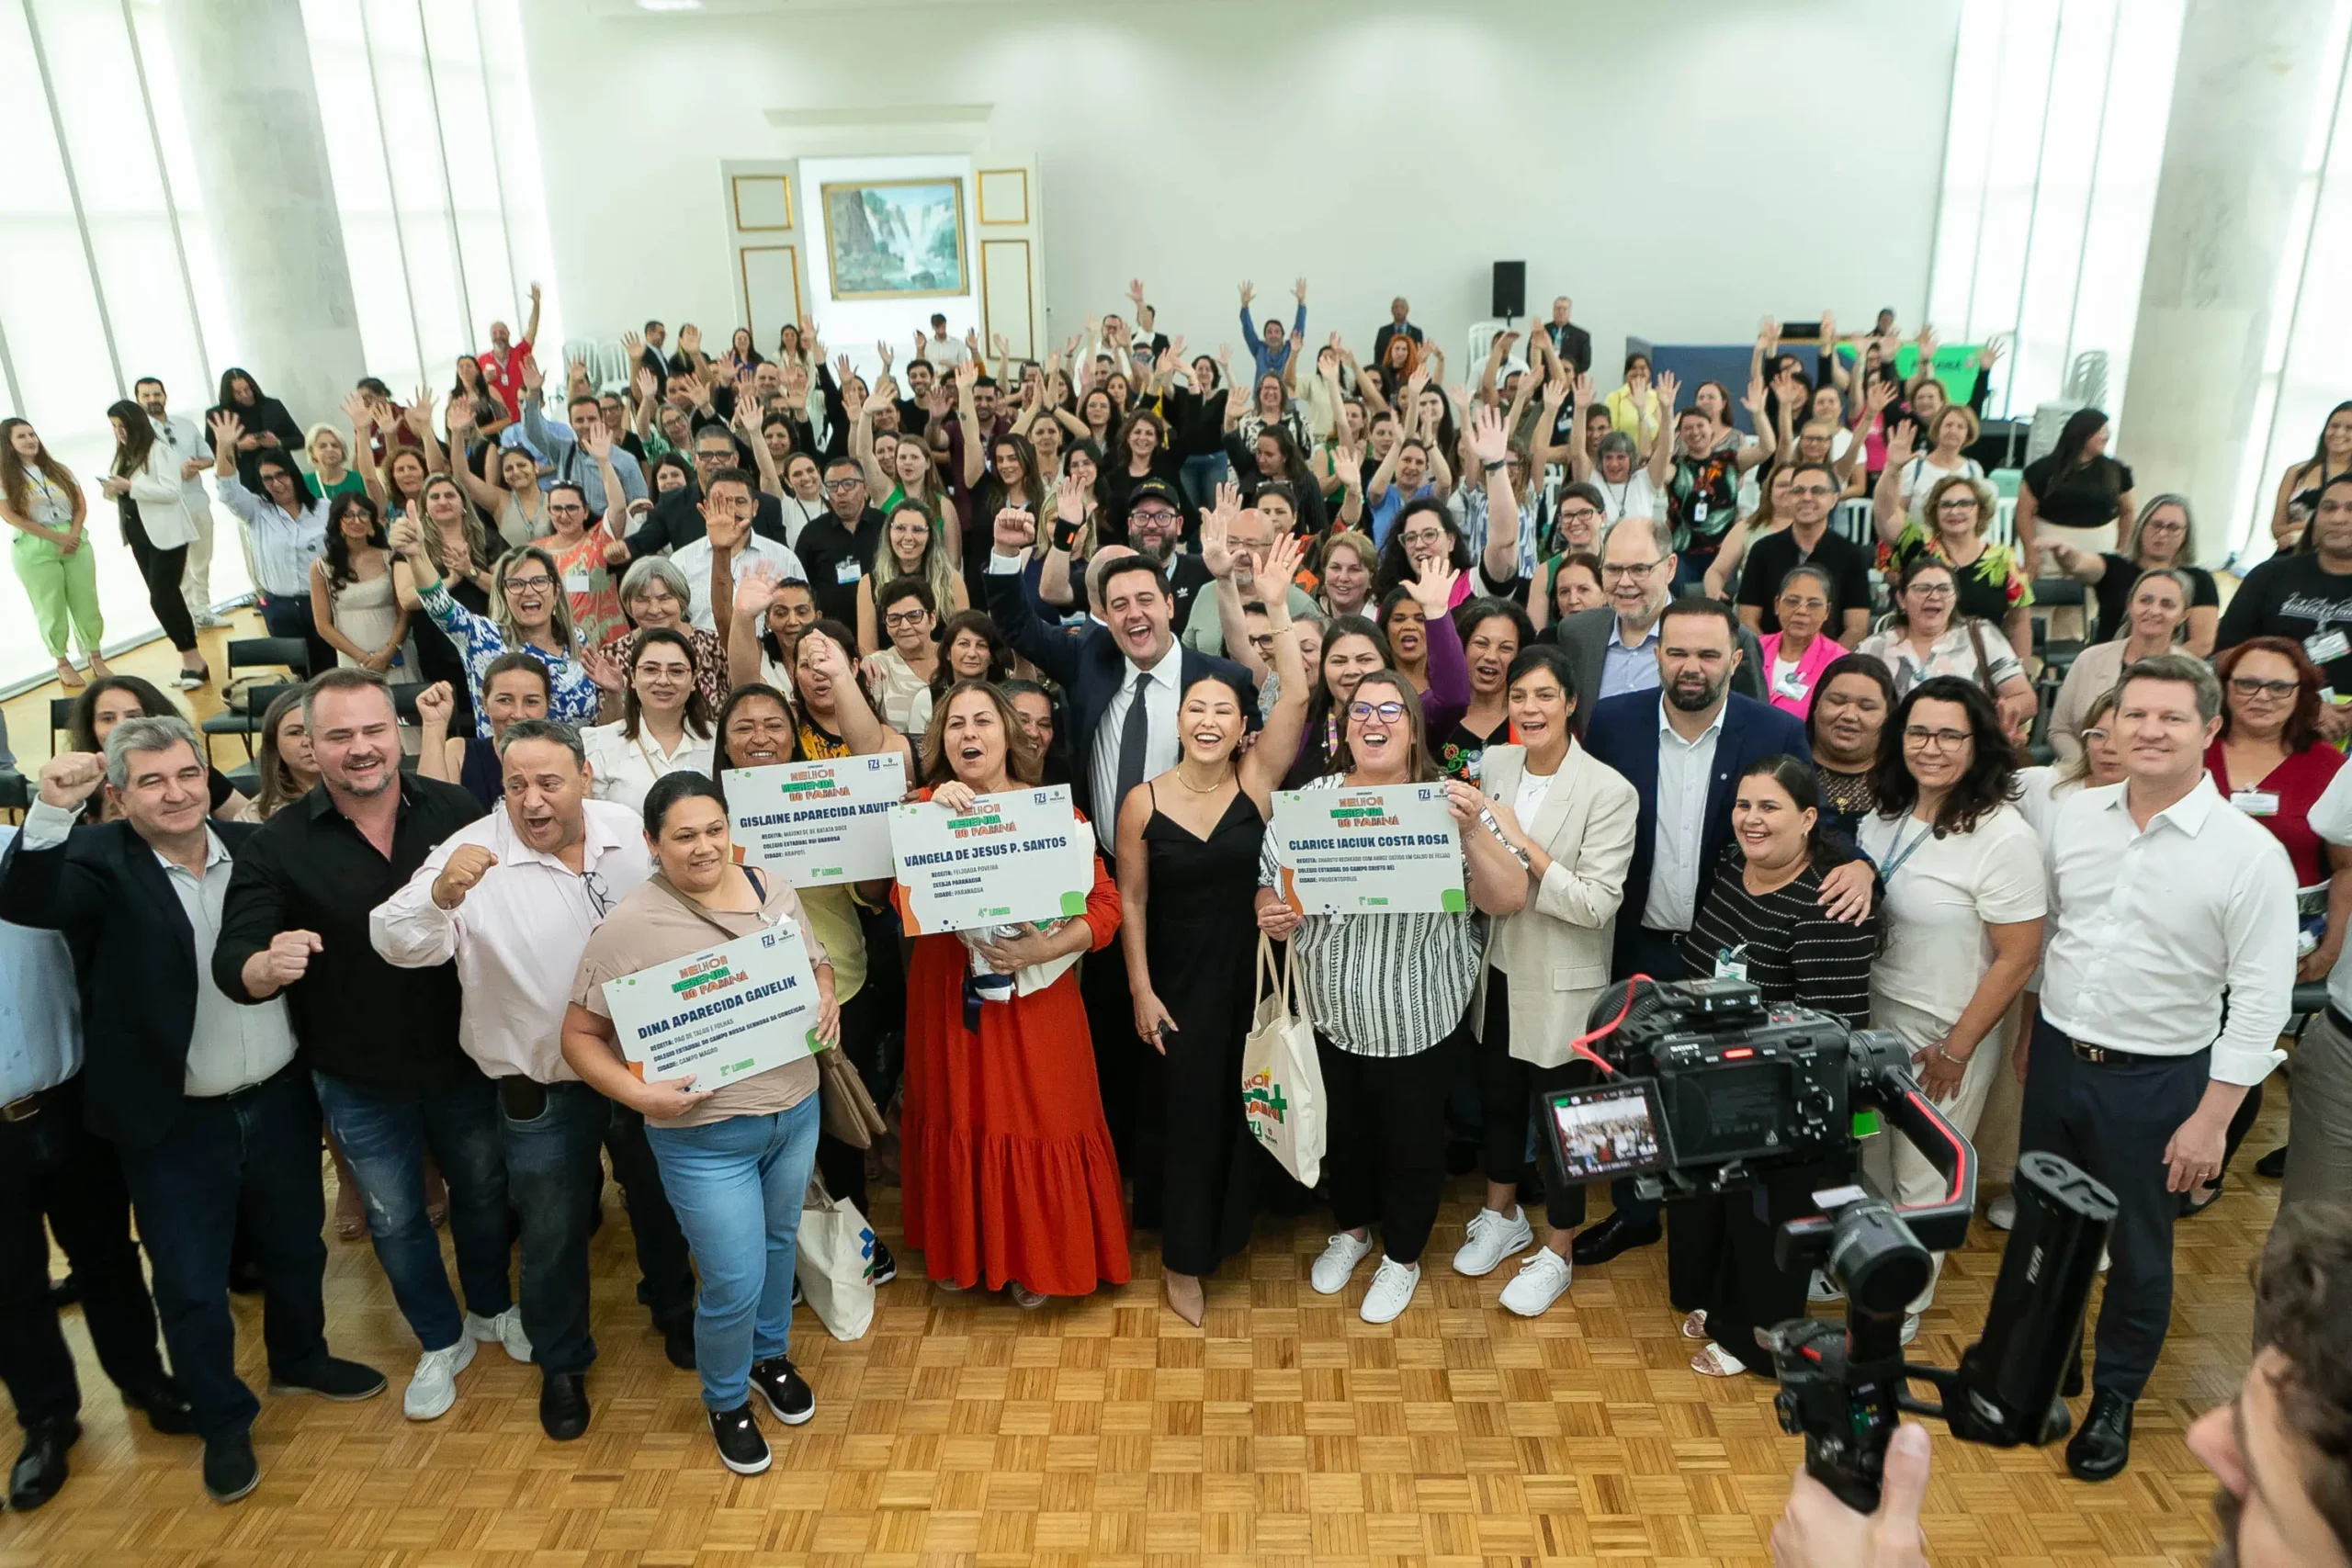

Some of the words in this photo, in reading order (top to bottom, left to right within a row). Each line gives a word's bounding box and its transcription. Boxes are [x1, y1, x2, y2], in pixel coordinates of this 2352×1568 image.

[790, 768, 834, 781] MELHOR
[781, 779, 834, 793] MERENDA
[789, 792, 803, 802] DO
[806, 785, 851, 799] PARANÁ
[1340, 796, 1384, 807] MELHOR
[740, 813, 791, 828] GISLAINE
[793, 805, 855, 822] APARECIDA
[947, 815, 1001, 829] MERENDA
[1330, 807, 1384, 818] MERENDA
[1338, 818, 1351, 828] DO
[1354, 814, 1399, 827] PARANÁ
[956, 829, 968, 839] DO
[972, 820, 1016, 836] PARANÁ
[956, 849, 969, 861] DE
[972, 843, 1008, 859] JESUS
[1010, 842, 1021, 854] P.
[1023, 836, 1067, 852] SANTOS
[1289, 839, 1335, 851] CLARICE
[1338, 837, 1375, 849] IACIUK
[1378, 835, 1415, 847] COSTA
[1418, 834, 1449, 845] ROSA
[932, 870, 953, 878] RECEITA:
[679, 955, 729, 978] MELHOR
[672, 966, 730, 993] MERENDA
[682, 988, 697, 1000] DO
[699, 969, 749, 995] PARANÁ
[673, 995, 744, 1029] APARECIDA
[746, 976, 797, 1003] GAVELIK
[650, 1040, 673, 1052] RECEITA:
[693, 1027, 710, 1038] TALOS
[715, 1019, 734, 1030] FOLHAS
[676, 1042, 700, 1055] ESTADUAL
[709, 1032, 729, 1043] CAMPO
[729, 1025, 746, 1036] NOSSA
[746, 1018, 770, 1030] SENHORA
[679, 1055, 698, 1066] CAMPO
[699, 1046, 718, 1058] MAGRO
